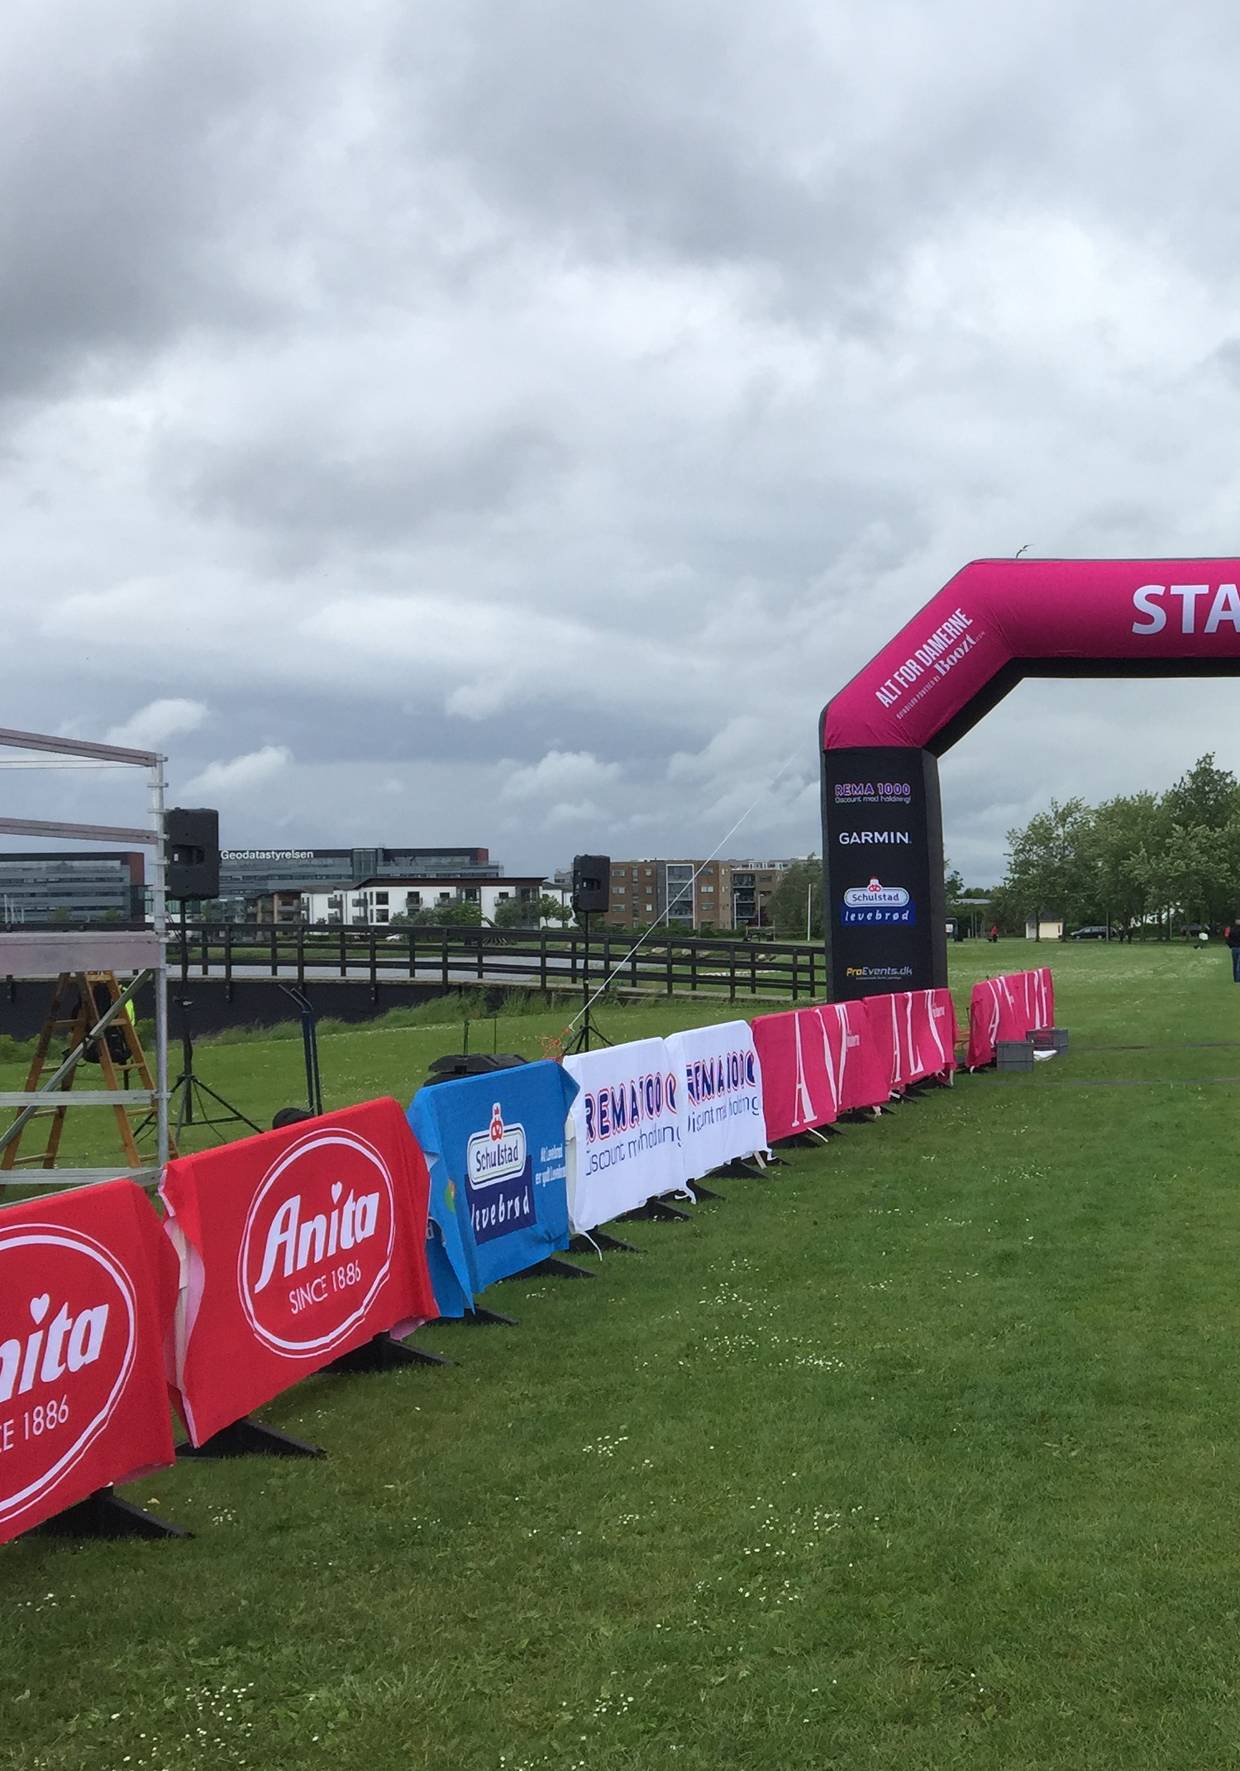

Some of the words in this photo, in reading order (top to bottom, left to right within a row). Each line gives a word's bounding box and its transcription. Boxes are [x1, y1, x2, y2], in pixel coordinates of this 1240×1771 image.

[875, 679, 902, 708] ALT
[893, 658, 925, 689] FOR
[914, 607, 973, 667] DAMERNE
[834, 783, 875, 796] REMA
[877, 783, 911, 796] 1000
[839, 831, 910, 845] GARMIN
[220, 849, 314, 861] Geodatastyrelsen
[852, 893, 900, 902] Schulstad
[845, 909, 910, 922] levebrød
[846, 966, 913, 977] ProEvents.dk
[475, 1139, 519, 1172] Schulstad
[254, 1181, 380, 1294] Anita
[288, 1273, 328, 1315] SINCE
[331, 1264, 362, 1293] 1886
[0, 1293, 109, 1403] nita
[23, 1394, 69, 1441] 1886
